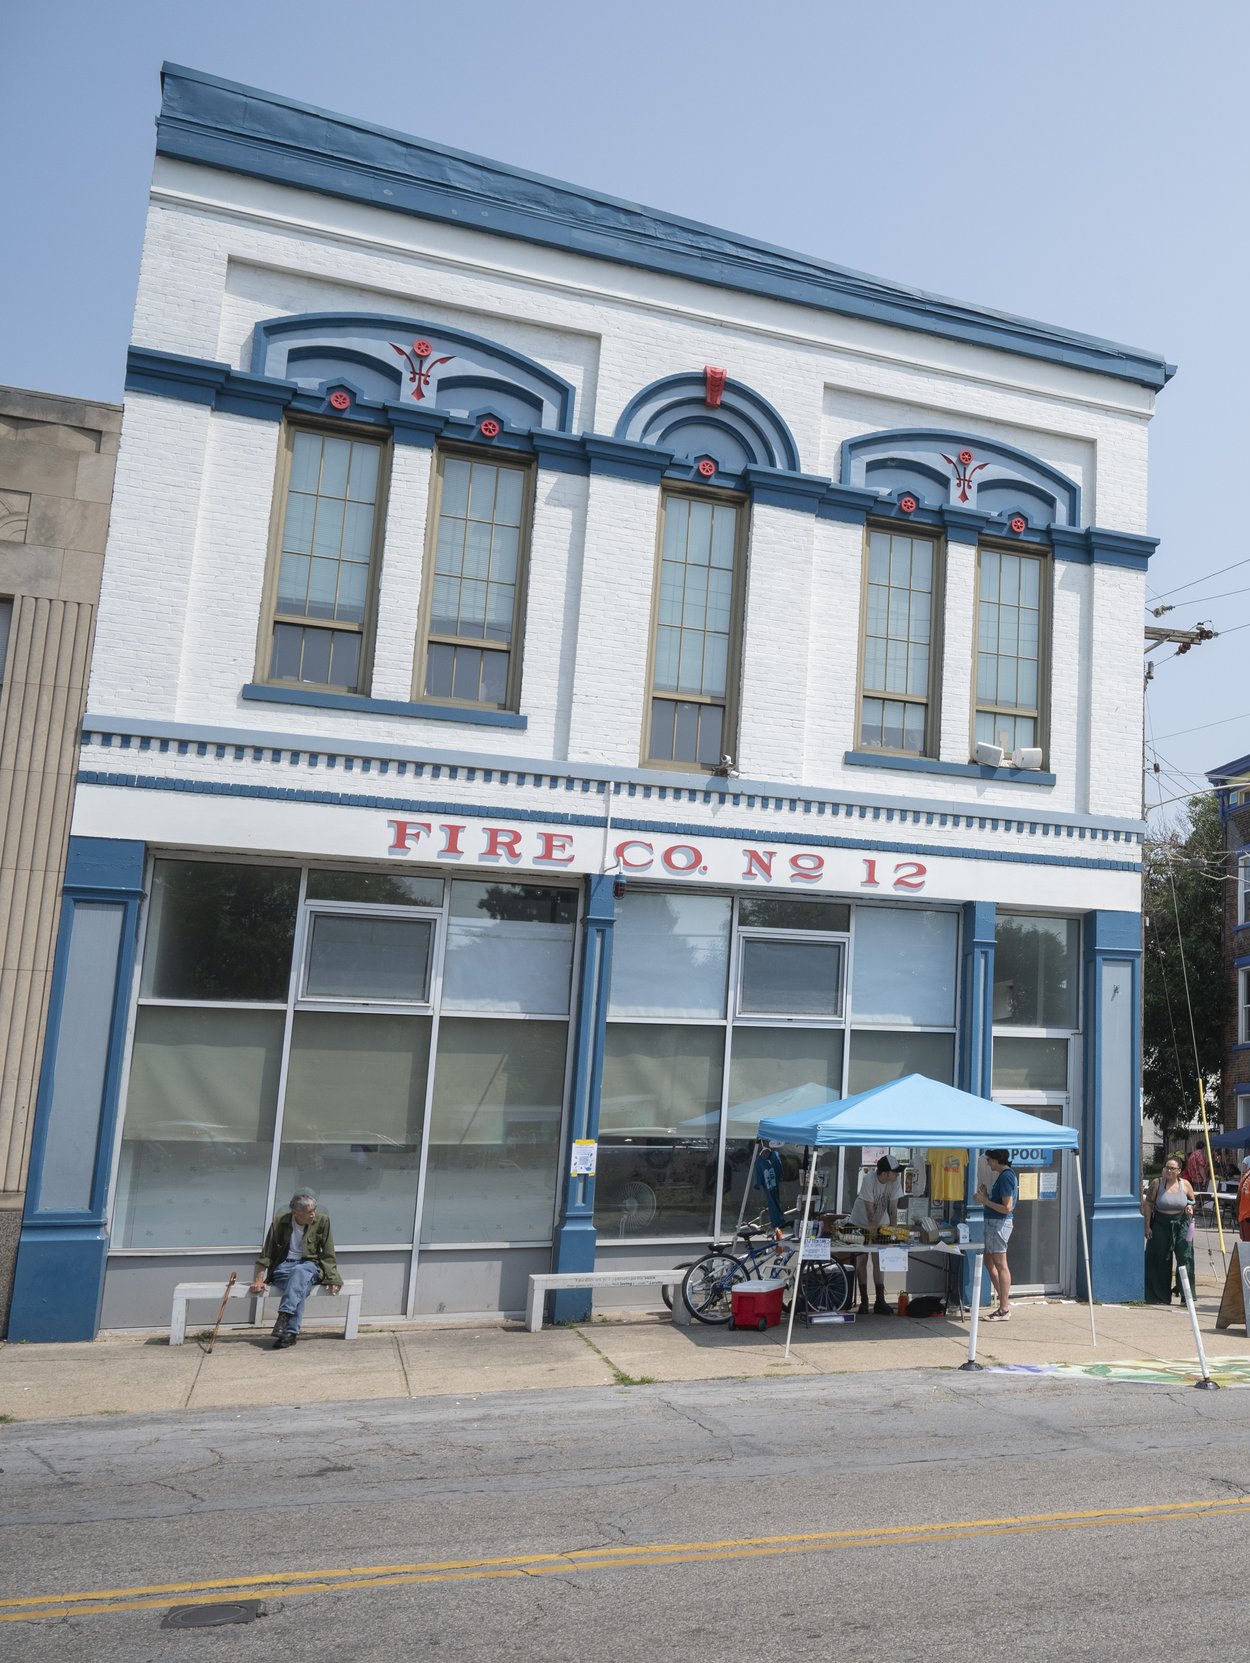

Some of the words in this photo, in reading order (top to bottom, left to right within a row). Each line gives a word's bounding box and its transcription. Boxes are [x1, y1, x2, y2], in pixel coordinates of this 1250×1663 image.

[387, 819, 576, 865] FIRE
[613, 839, 709, 876] CO.
[860, 858, 927, 892] 12
